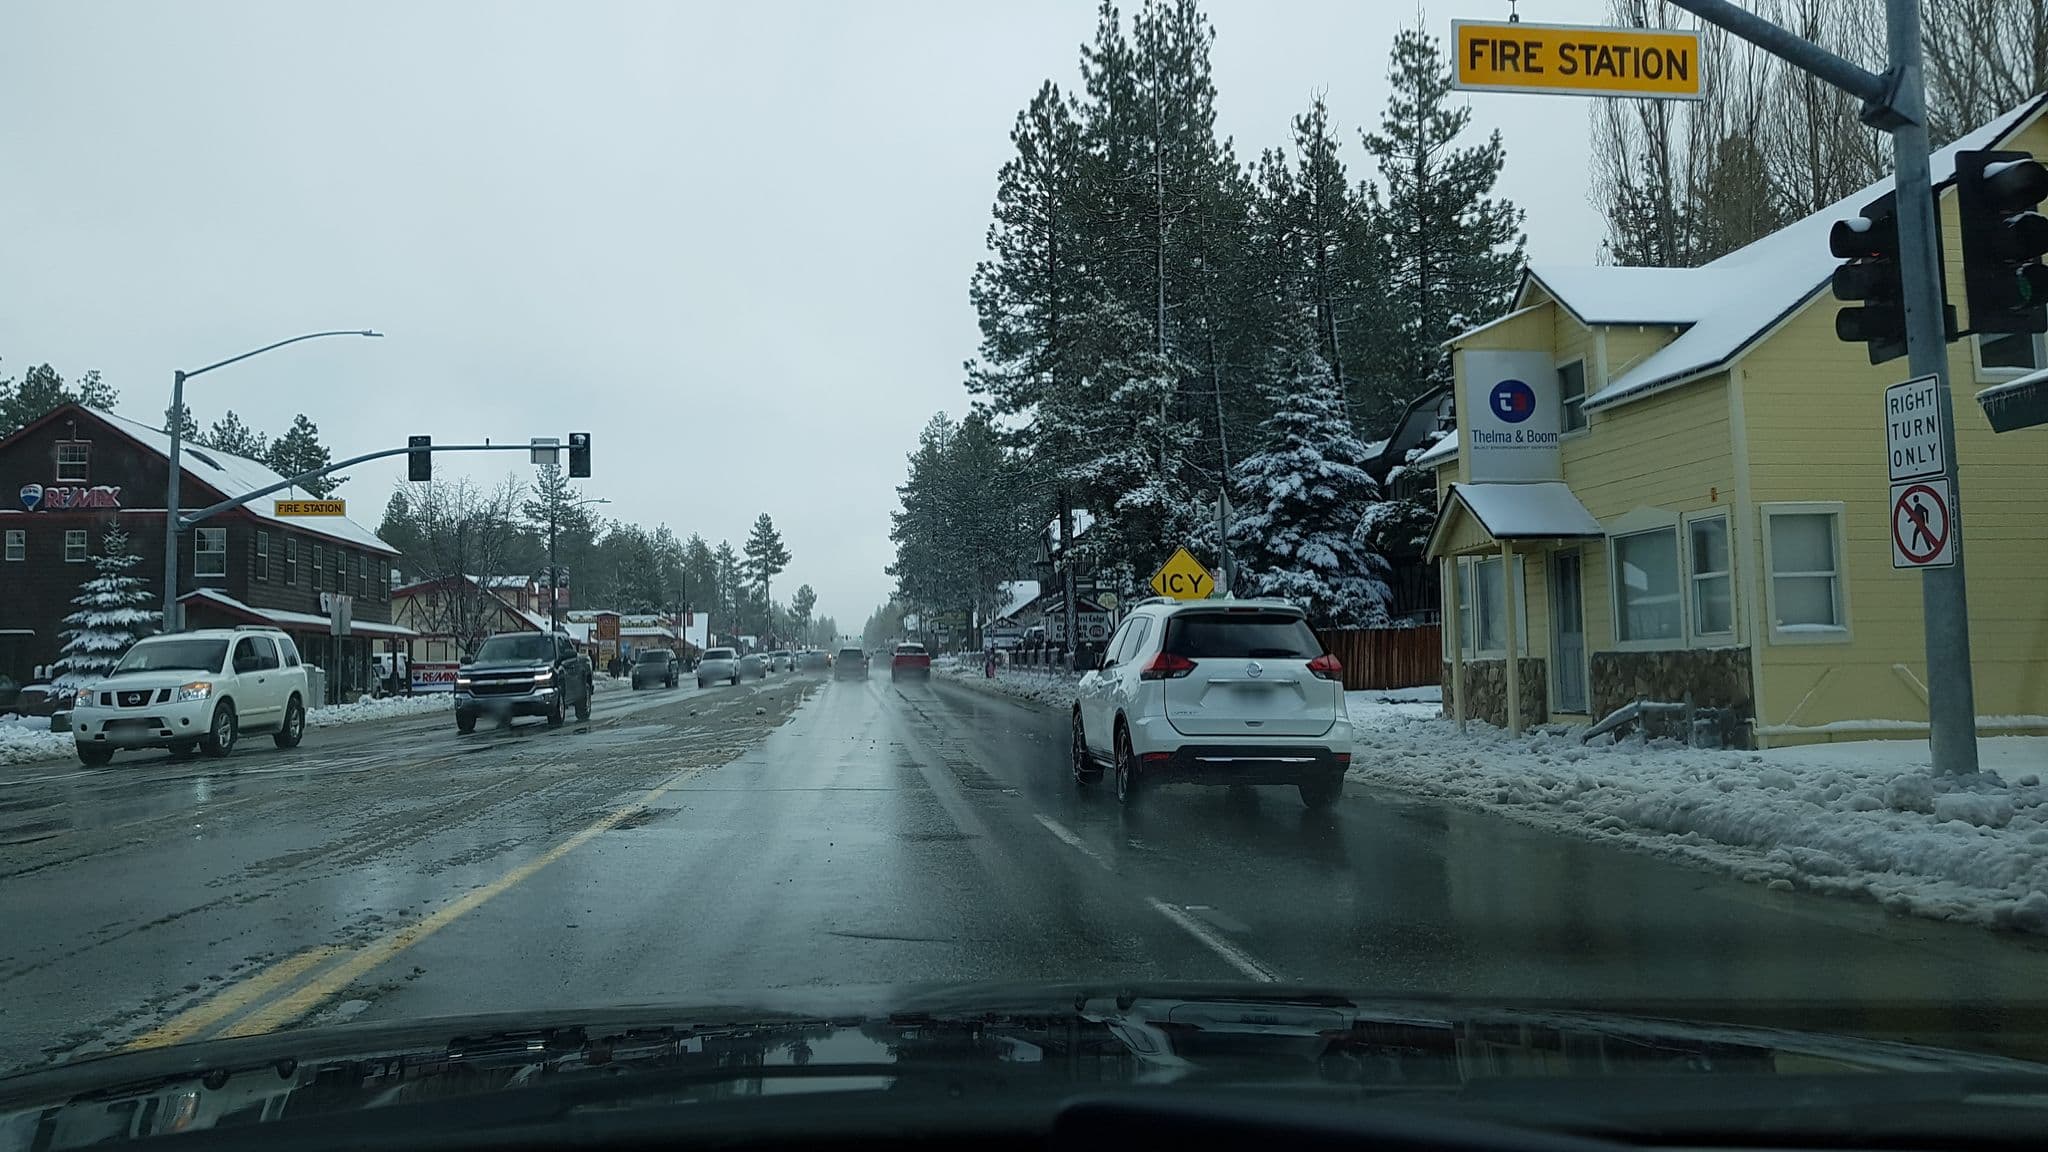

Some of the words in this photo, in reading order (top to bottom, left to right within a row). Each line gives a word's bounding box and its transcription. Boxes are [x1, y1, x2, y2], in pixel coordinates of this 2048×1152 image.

[1469, 38, 1544, 73] FIRE
[1558, 42, 1688, 81] STATION
[1890, 388, 1934, 415] RIGHT
[1472, 429, 1512, 443] Thelma
[1515, 429, 1524, 443] &
[1527, 429, 1558, 443] Boom
[1892, 415, 1936, 440] TURN
[1893, 443, 1937, 467] ONLY
[44, 487, 121, 508] RE/MAX
[278, 504, 300, 513] FIRE
[303, 504, 341, 513] STATION
[1162, 573, 1204, 594] ICY
